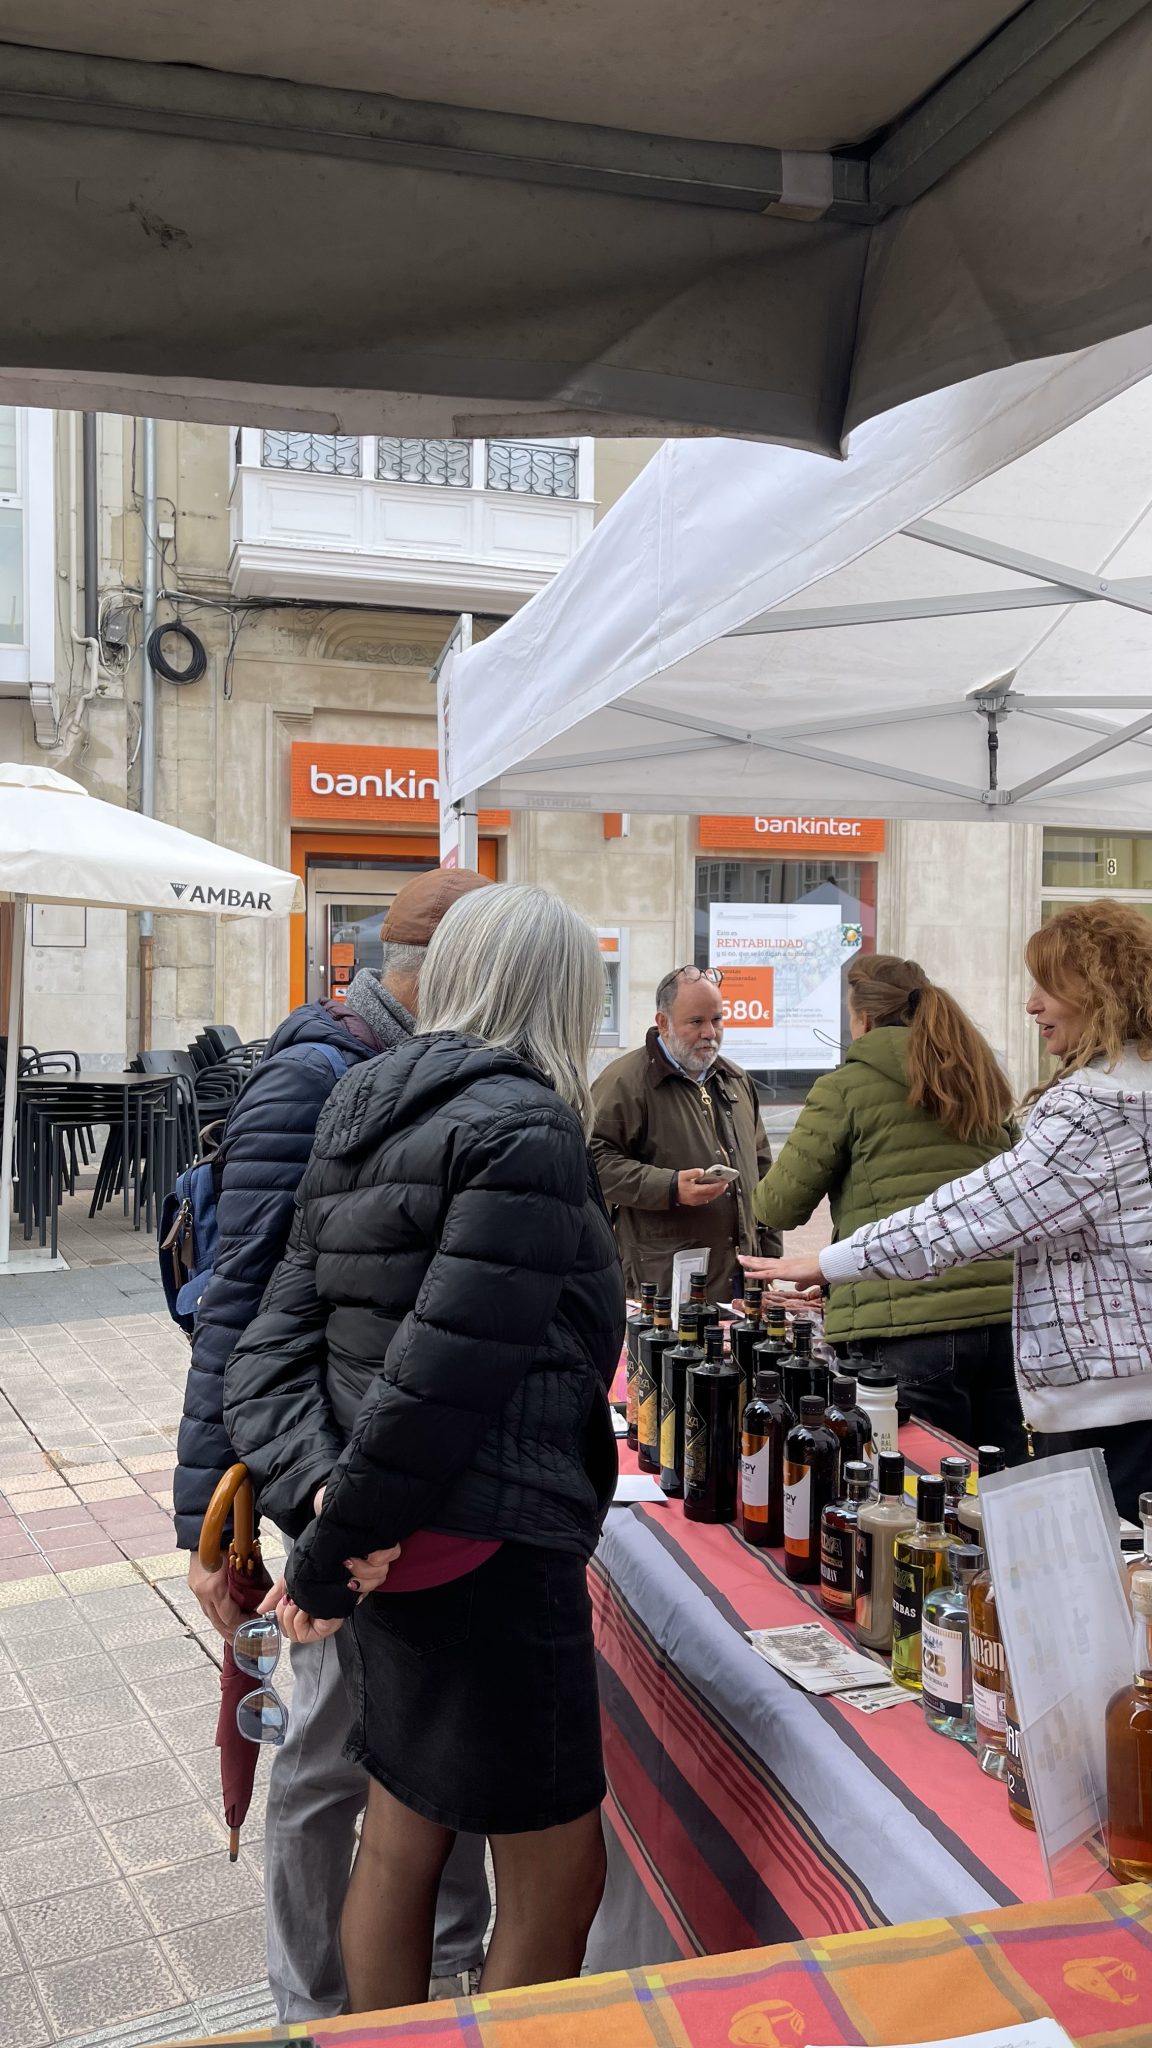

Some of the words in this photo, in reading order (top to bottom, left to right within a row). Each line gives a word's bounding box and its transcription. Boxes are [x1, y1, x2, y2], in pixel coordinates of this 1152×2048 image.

[1107, 859, 1116, 874] 8
[189, 885, 273, 911] AMBAR
[716, 929, 730, 937] Esto
[716, 938, 803, 949] RENTABILIDAD
[893, 1600, 917, 1618] ERBAS
